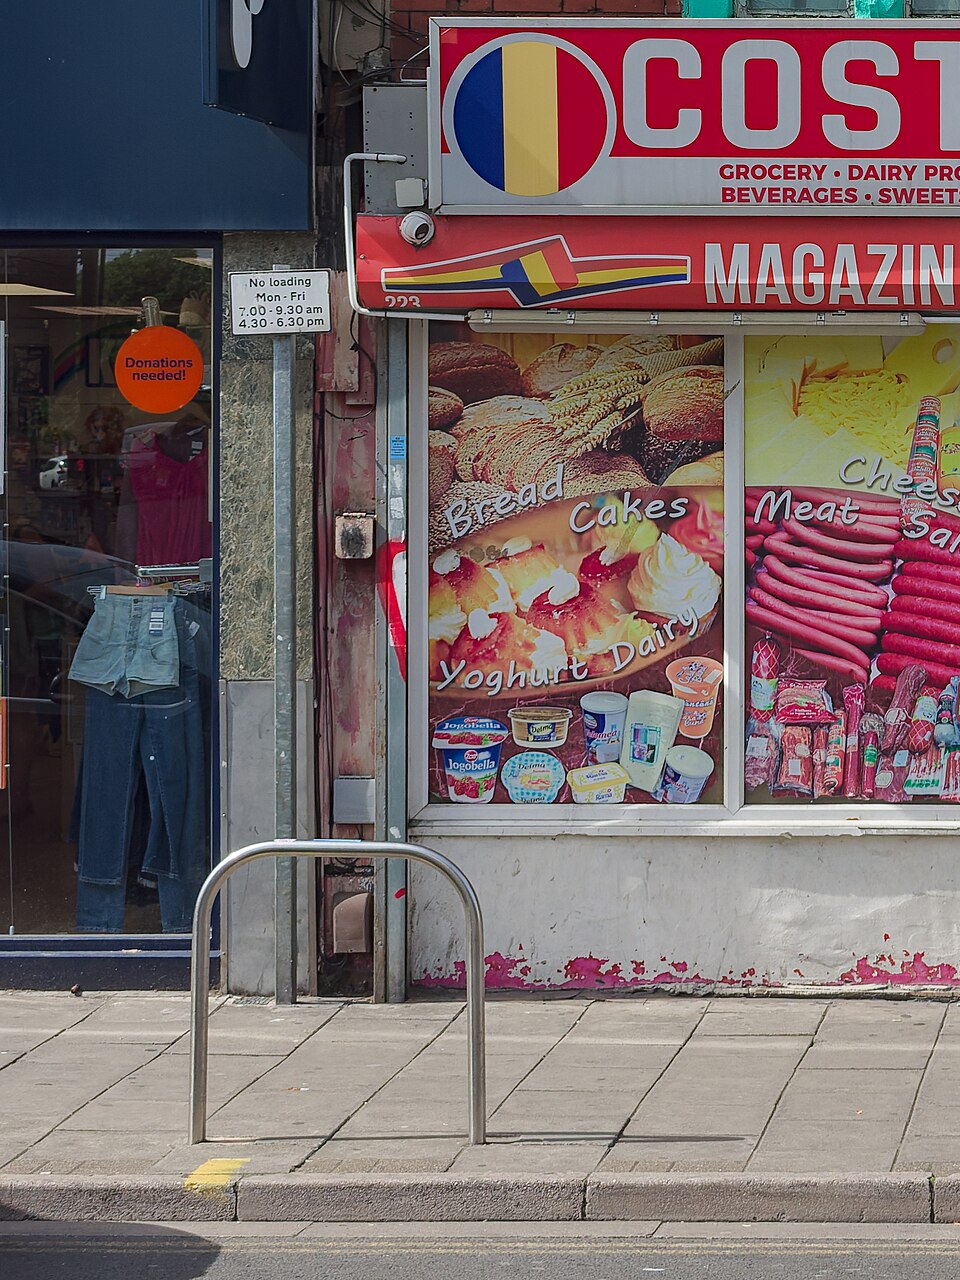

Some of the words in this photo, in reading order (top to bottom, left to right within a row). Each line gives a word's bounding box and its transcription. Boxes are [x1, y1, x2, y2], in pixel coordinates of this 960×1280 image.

[719, 164, 828, 181] GROCERY
[848, 164, 918, 181] DAIRY
[721, 187, 858, 204] BEVERAGES
[249, 278, 266, 288] No
[269, 276, 312, 288] loading
[255, 292, 281, 302] Mon
[290, 291, 306, 301] Fri
[385, 295, 421, 308] 223
[306, 306, 323, 314] am
[307, 317, 325, 328] pm
[125, 357, 193, 368] Donations
[132, 370, 187, 381] needed!
[444, 463, 565, 539] Bread
[753, 490, 860, 525] Meat
[568, 491, 689, 534] Cakes
[437, 660, 590, 697] Yoghurt
[609, 606, 699, 672] Dairy
[443, 722, 501, 731] Jogobella
[448, 758, 496, 773] Jogobella
